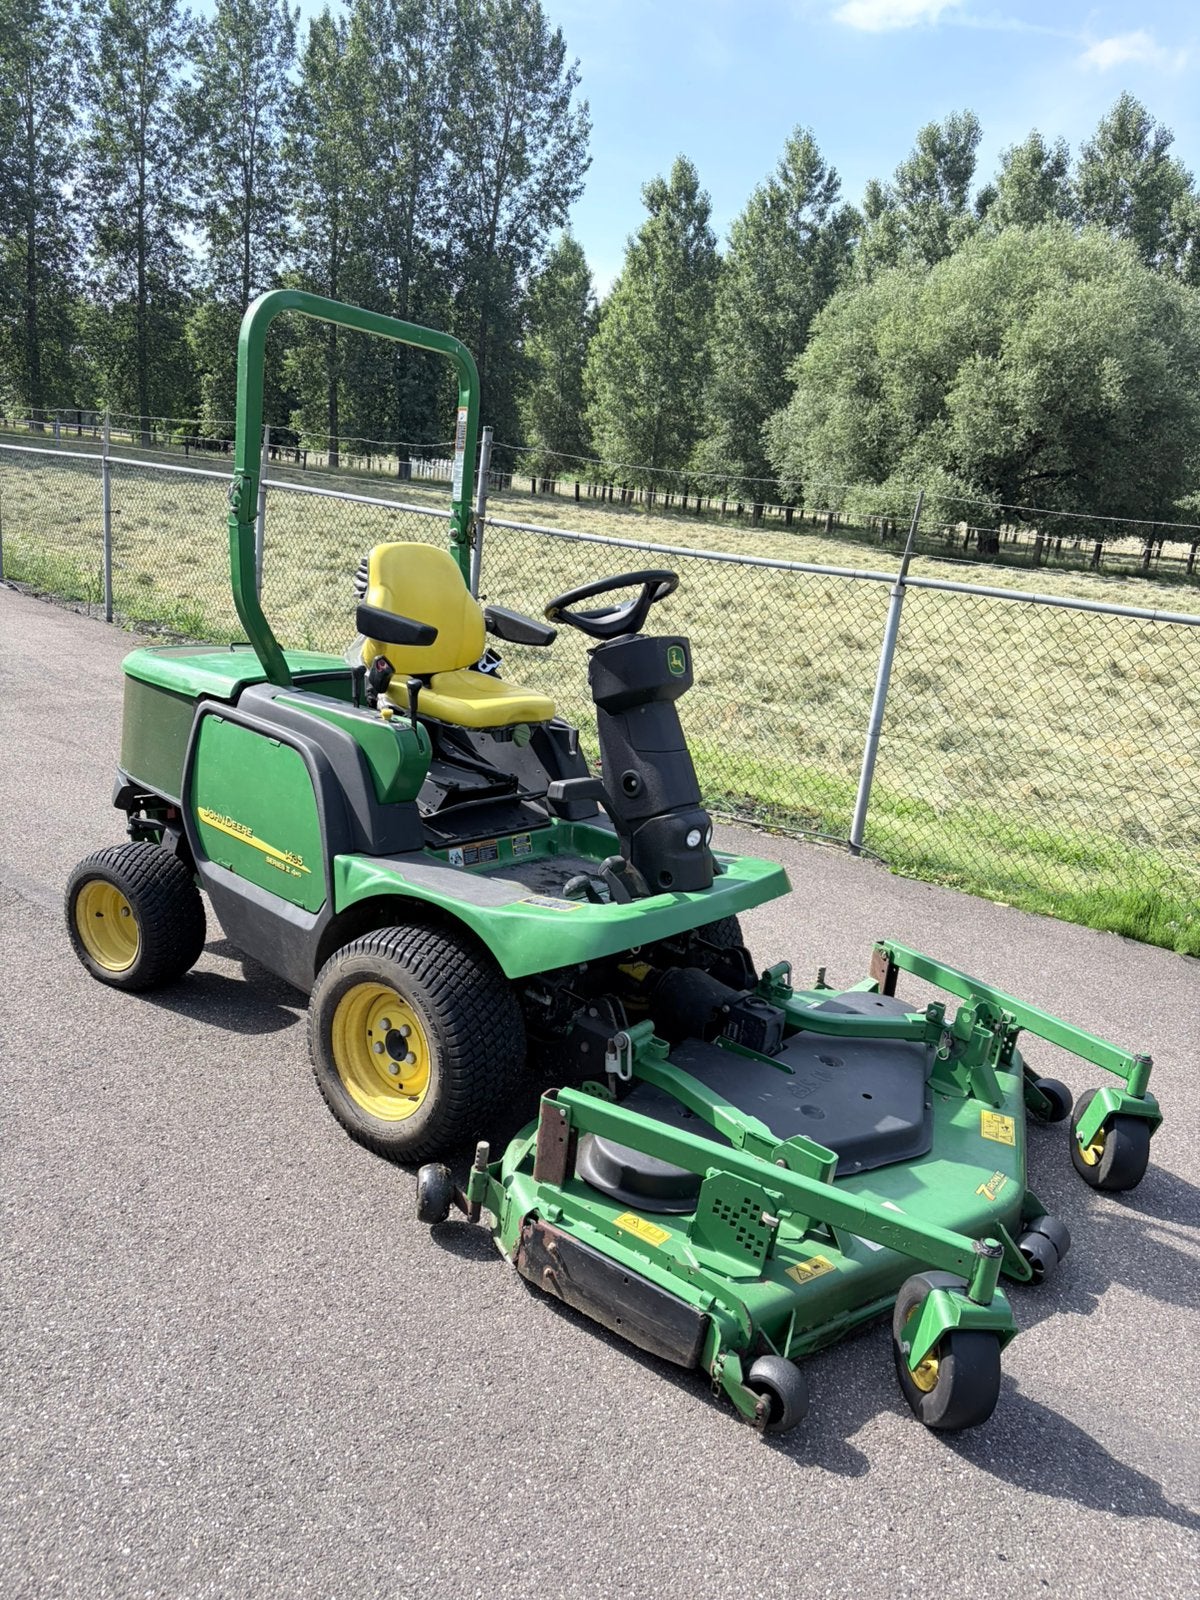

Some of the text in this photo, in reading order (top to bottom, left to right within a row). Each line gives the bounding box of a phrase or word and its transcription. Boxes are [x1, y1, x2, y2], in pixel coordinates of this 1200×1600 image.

[204, 806, 253, 838] JOHN DEERE
[975, 1183, 996, 1201] 7
